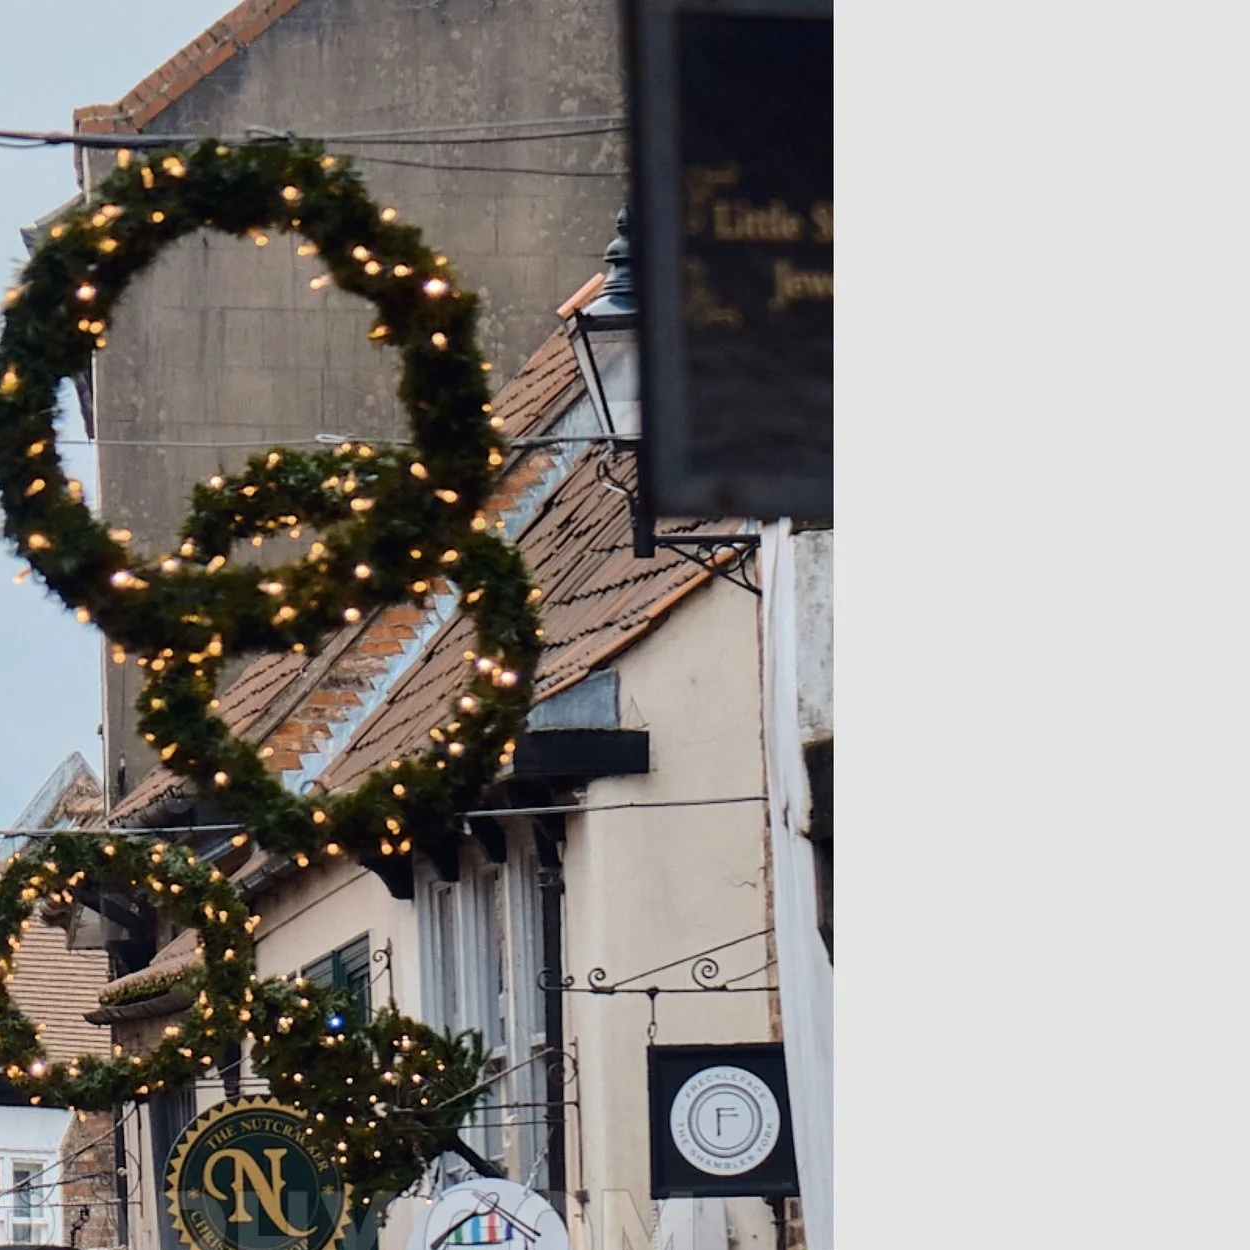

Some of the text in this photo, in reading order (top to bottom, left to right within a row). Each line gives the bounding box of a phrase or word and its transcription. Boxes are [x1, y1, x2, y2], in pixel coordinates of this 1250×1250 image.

[685, 1072, 768, 1101] FRECKLEFACE
[715, 1107, 740, 1136] F
[205, 1125, 237, 1151] THE
[202, 1147, 318, 1238] N
